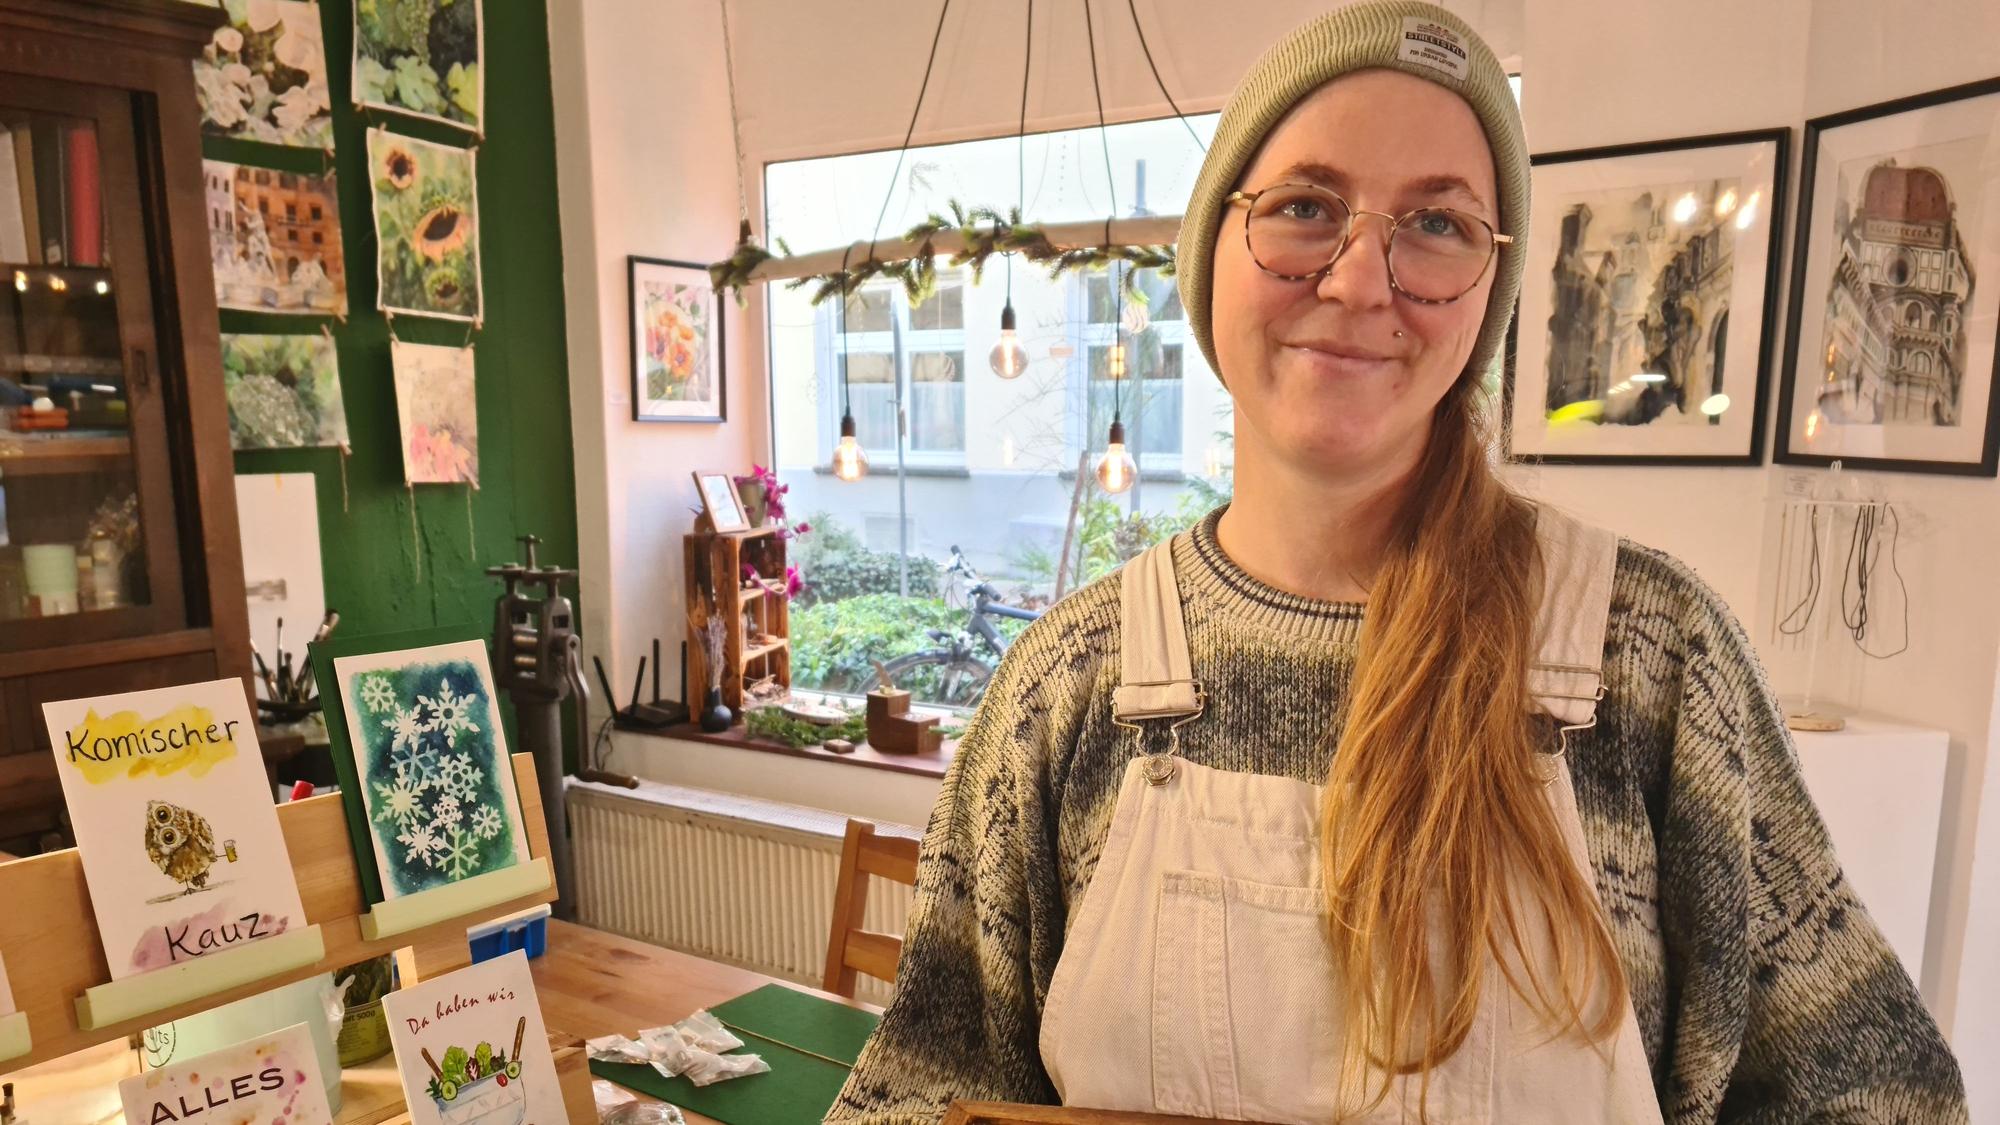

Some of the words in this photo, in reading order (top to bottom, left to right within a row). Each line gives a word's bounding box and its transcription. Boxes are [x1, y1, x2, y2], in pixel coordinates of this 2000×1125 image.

[1405, 32, 1466, 60] STREETSTYLE
[1420, 52, 1439, 61] URBAN
[65, 720, 239, 763] Komischer
[164, 912, 270, 961] Kauz
[406, 1018, 430, 1036] Da
[436, 994, 480, 1020] haben
[487, 987, 516, 1003] wir
[150, 1067, 285, 1125] ALLES
